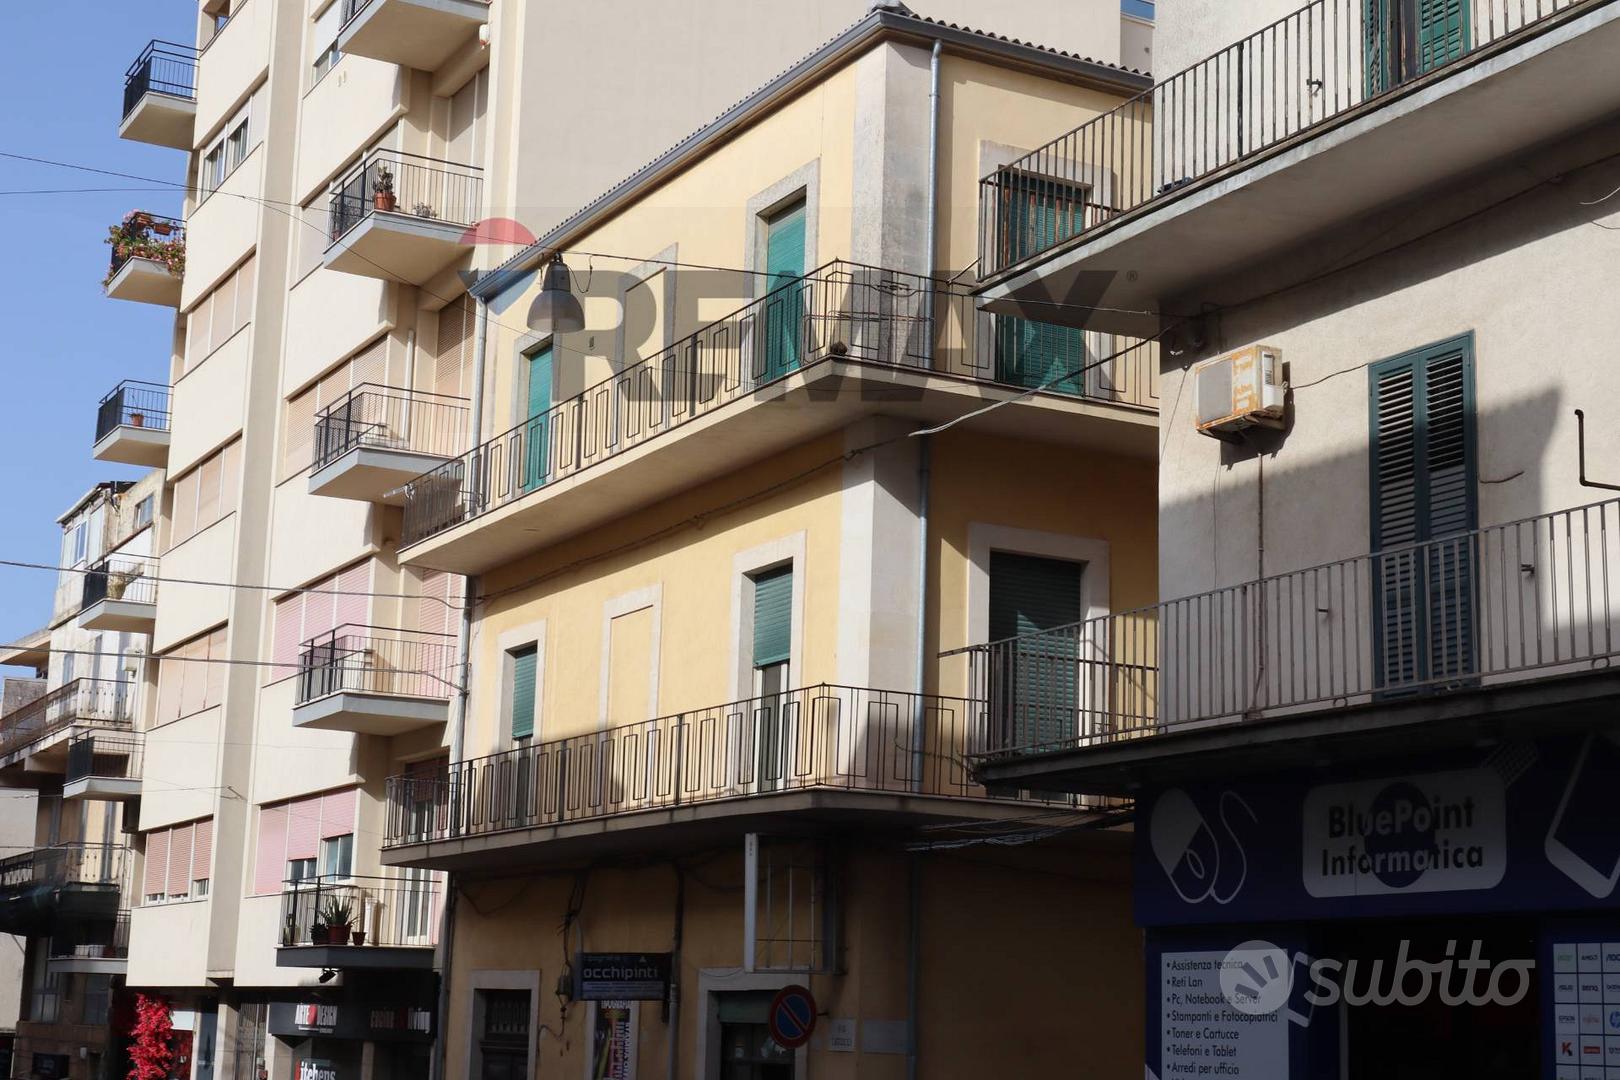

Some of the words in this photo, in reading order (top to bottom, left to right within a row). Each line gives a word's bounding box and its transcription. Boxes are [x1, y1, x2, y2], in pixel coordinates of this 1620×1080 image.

[1328, 796, 1475, 838] BluePoint
[1321, 840, 1483, 876] Informatica
[1171, 960, 1212, 970] Assistenza
[583, 966, 658, 980] occhipinti
[1171, 976, 1187, 987] Reti
[1188, 977, 1203, 987] Lan
[1185, 993, 1225, 1005] Notebook
[1171, 1011, 1212, 1024] Stampanti
[1222, 1011, 1278, 1024] Fotocopiatrici
[1171, 1028, 1194, 1040] Toner
[1203, 1028, 1239, 1040] Cartucce
[1171, 1045, 1203, 1057] Telefoni
[1212, 1045, 1237, 1057] Tablet
[1171, 1061, 1196, 1074] Arredi
[1198, 1064, 1212, 1076] per
